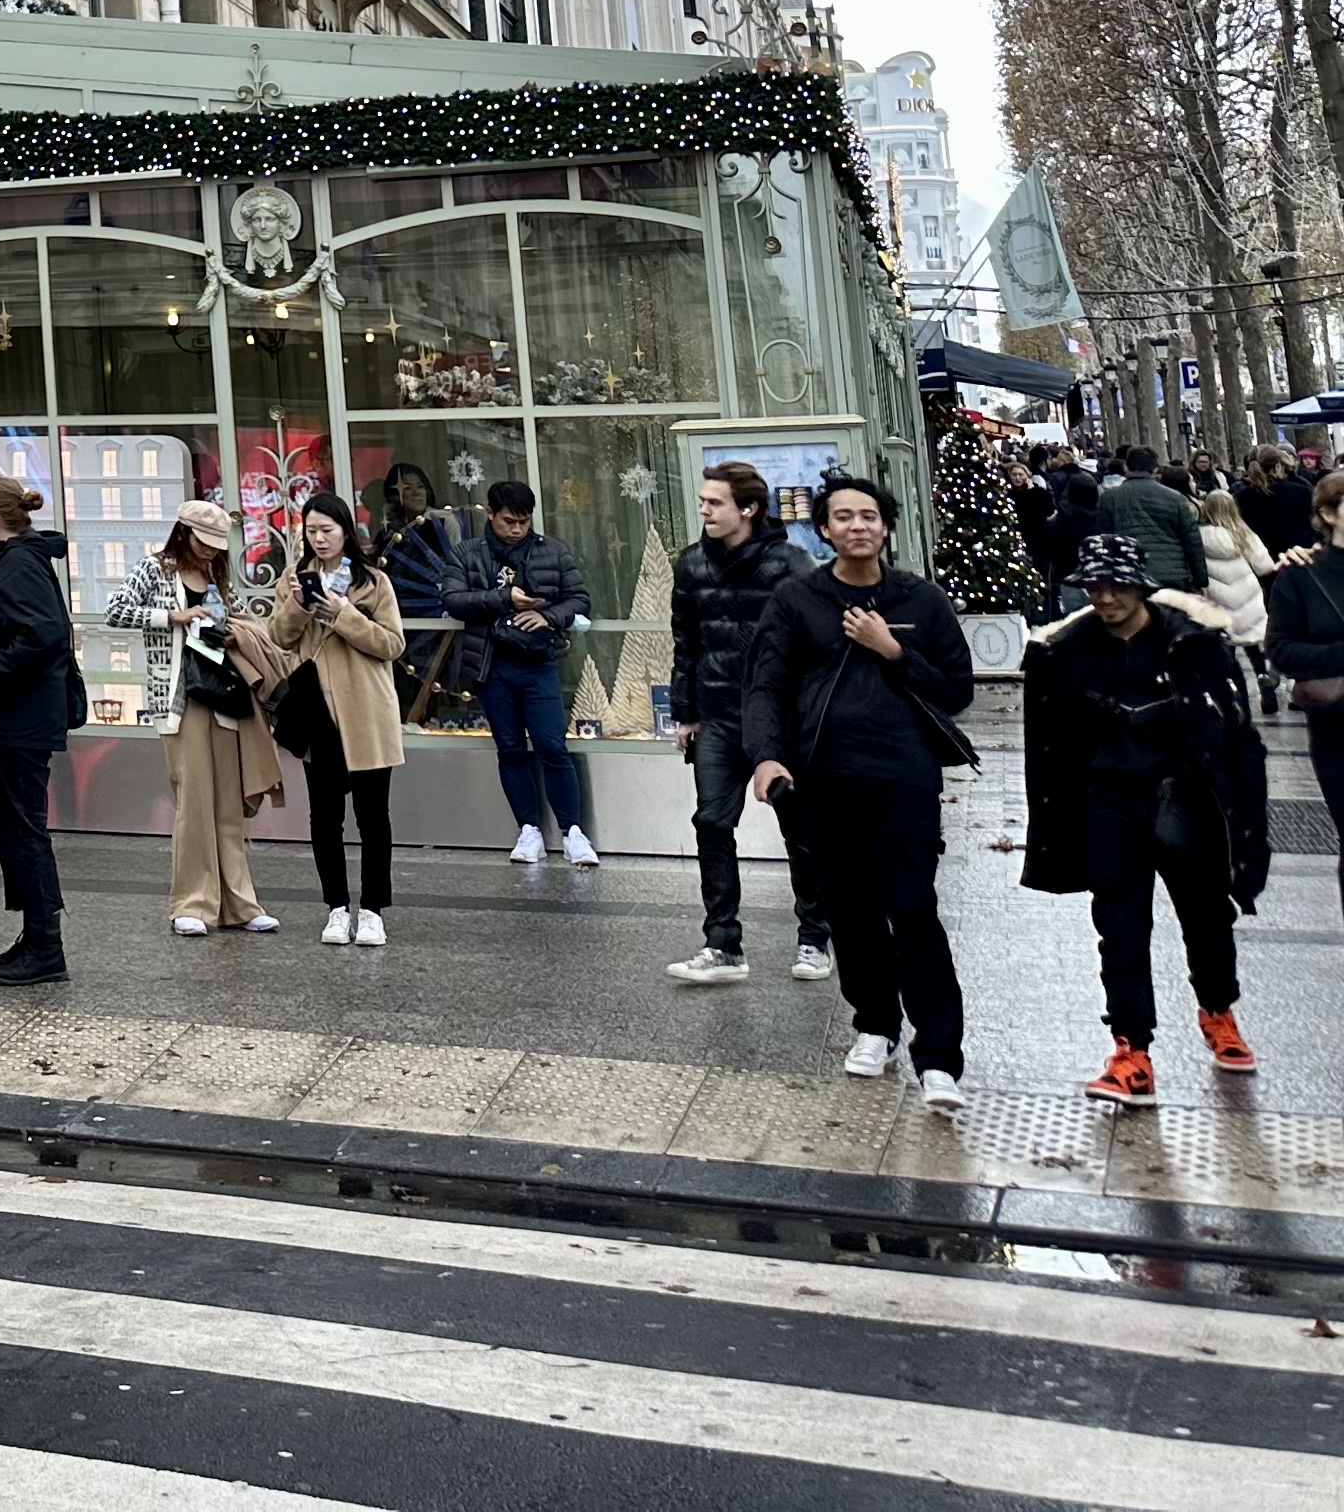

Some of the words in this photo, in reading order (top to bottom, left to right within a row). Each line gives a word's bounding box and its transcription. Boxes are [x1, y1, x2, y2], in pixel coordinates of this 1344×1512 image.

[897, 98, 936, 113] DIOR
[1187, 365, 1200, 385] P
[983, 635, 1000, 653] L
